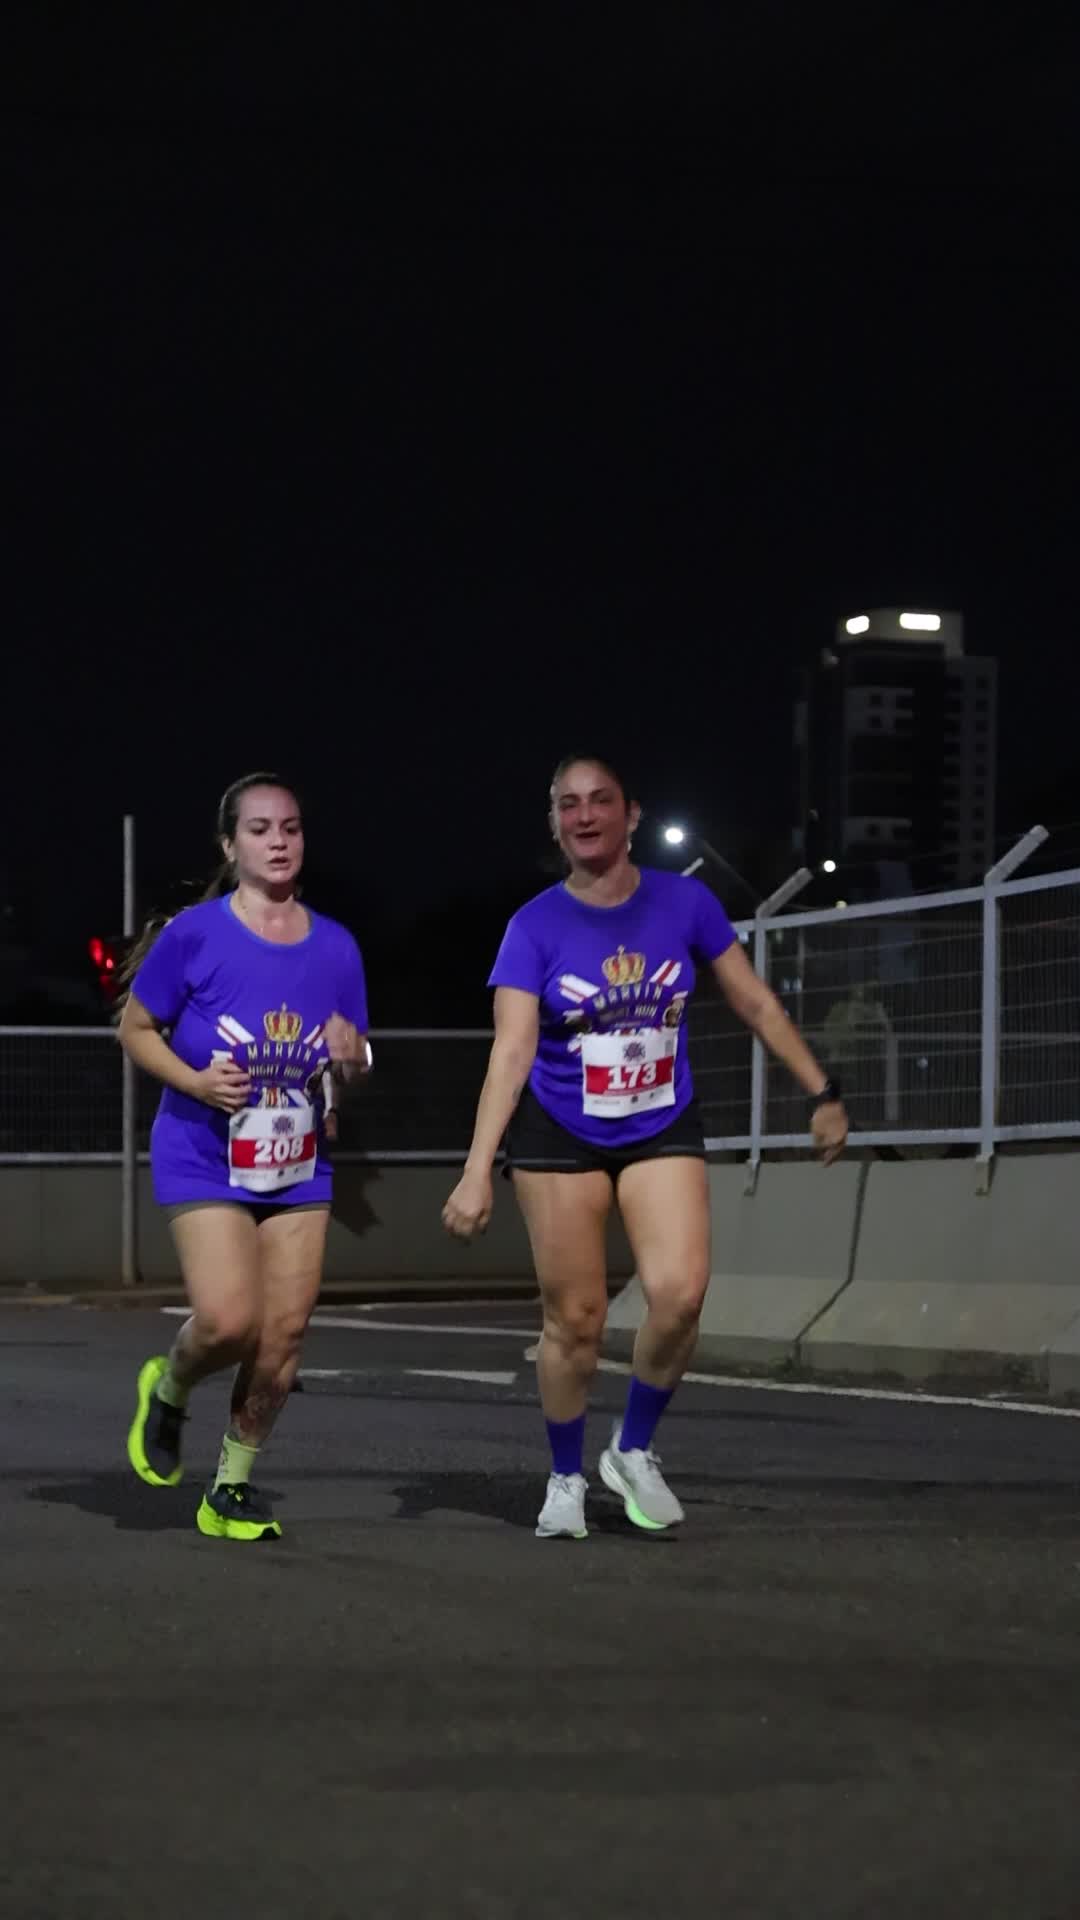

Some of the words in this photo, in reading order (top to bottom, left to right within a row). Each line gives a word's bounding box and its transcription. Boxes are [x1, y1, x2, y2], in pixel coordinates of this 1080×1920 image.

[247, 1042, 312, 1062] MARVIN
[248, 1064, 279, 1077] NIGHT
[608, 1062, 657, 1090] 173
[254, 1136, 304, 1164] 208
